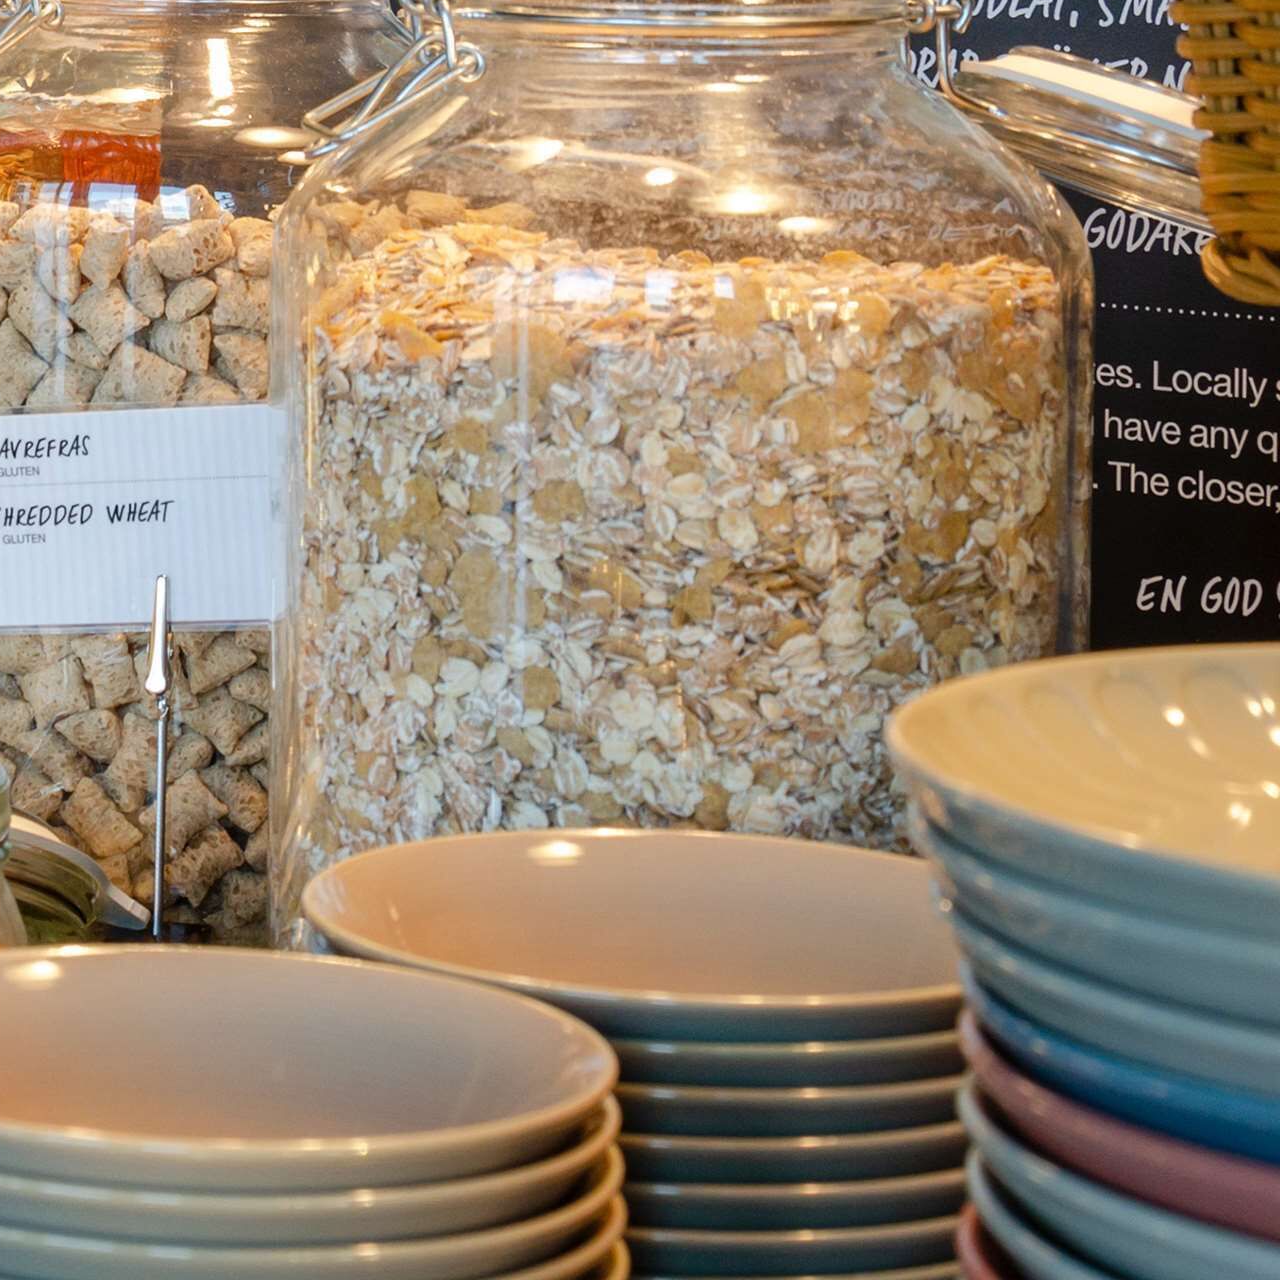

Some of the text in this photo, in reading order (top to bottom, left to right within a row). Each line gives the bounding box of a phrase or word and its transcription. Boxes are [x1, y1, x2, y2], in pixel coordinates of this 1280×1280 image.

[1153, 360, 1268, 408] Locally
[1104, 408, 1182, 446] have
[1189, 424, 1249, 460] any
[1107, 460, 1280, 514] The closer,
[106, 499, 175, 525] WHEAT
[2, 532, 47, 545] GLUTEN
[1136, 575, 1187, 613] EN
[1200, 575, 1263, 617] GOD
